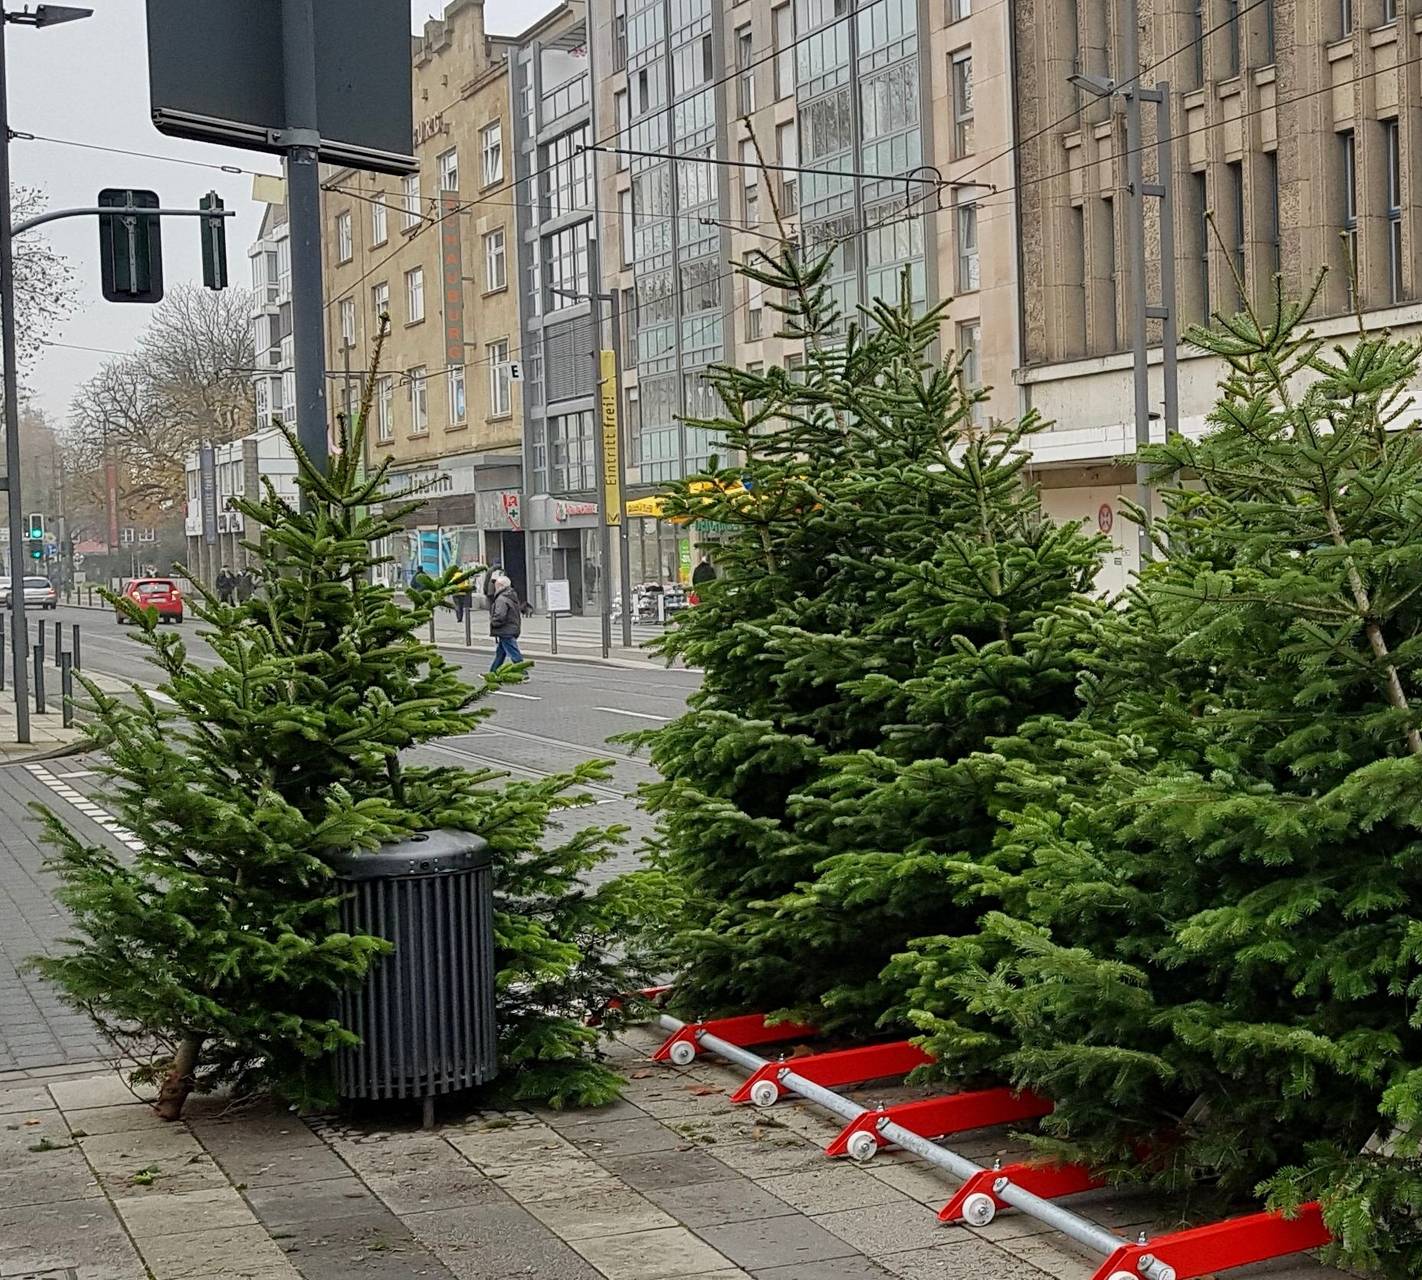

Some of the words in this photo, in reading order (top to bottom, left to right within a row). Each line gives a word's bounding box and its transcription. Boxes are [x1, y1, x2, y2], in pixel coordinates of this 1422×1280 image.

[511, 365, 519, 378] E
[603, 396, 616, 428] frei!
[604, 434, 617, 486] Eintritt
